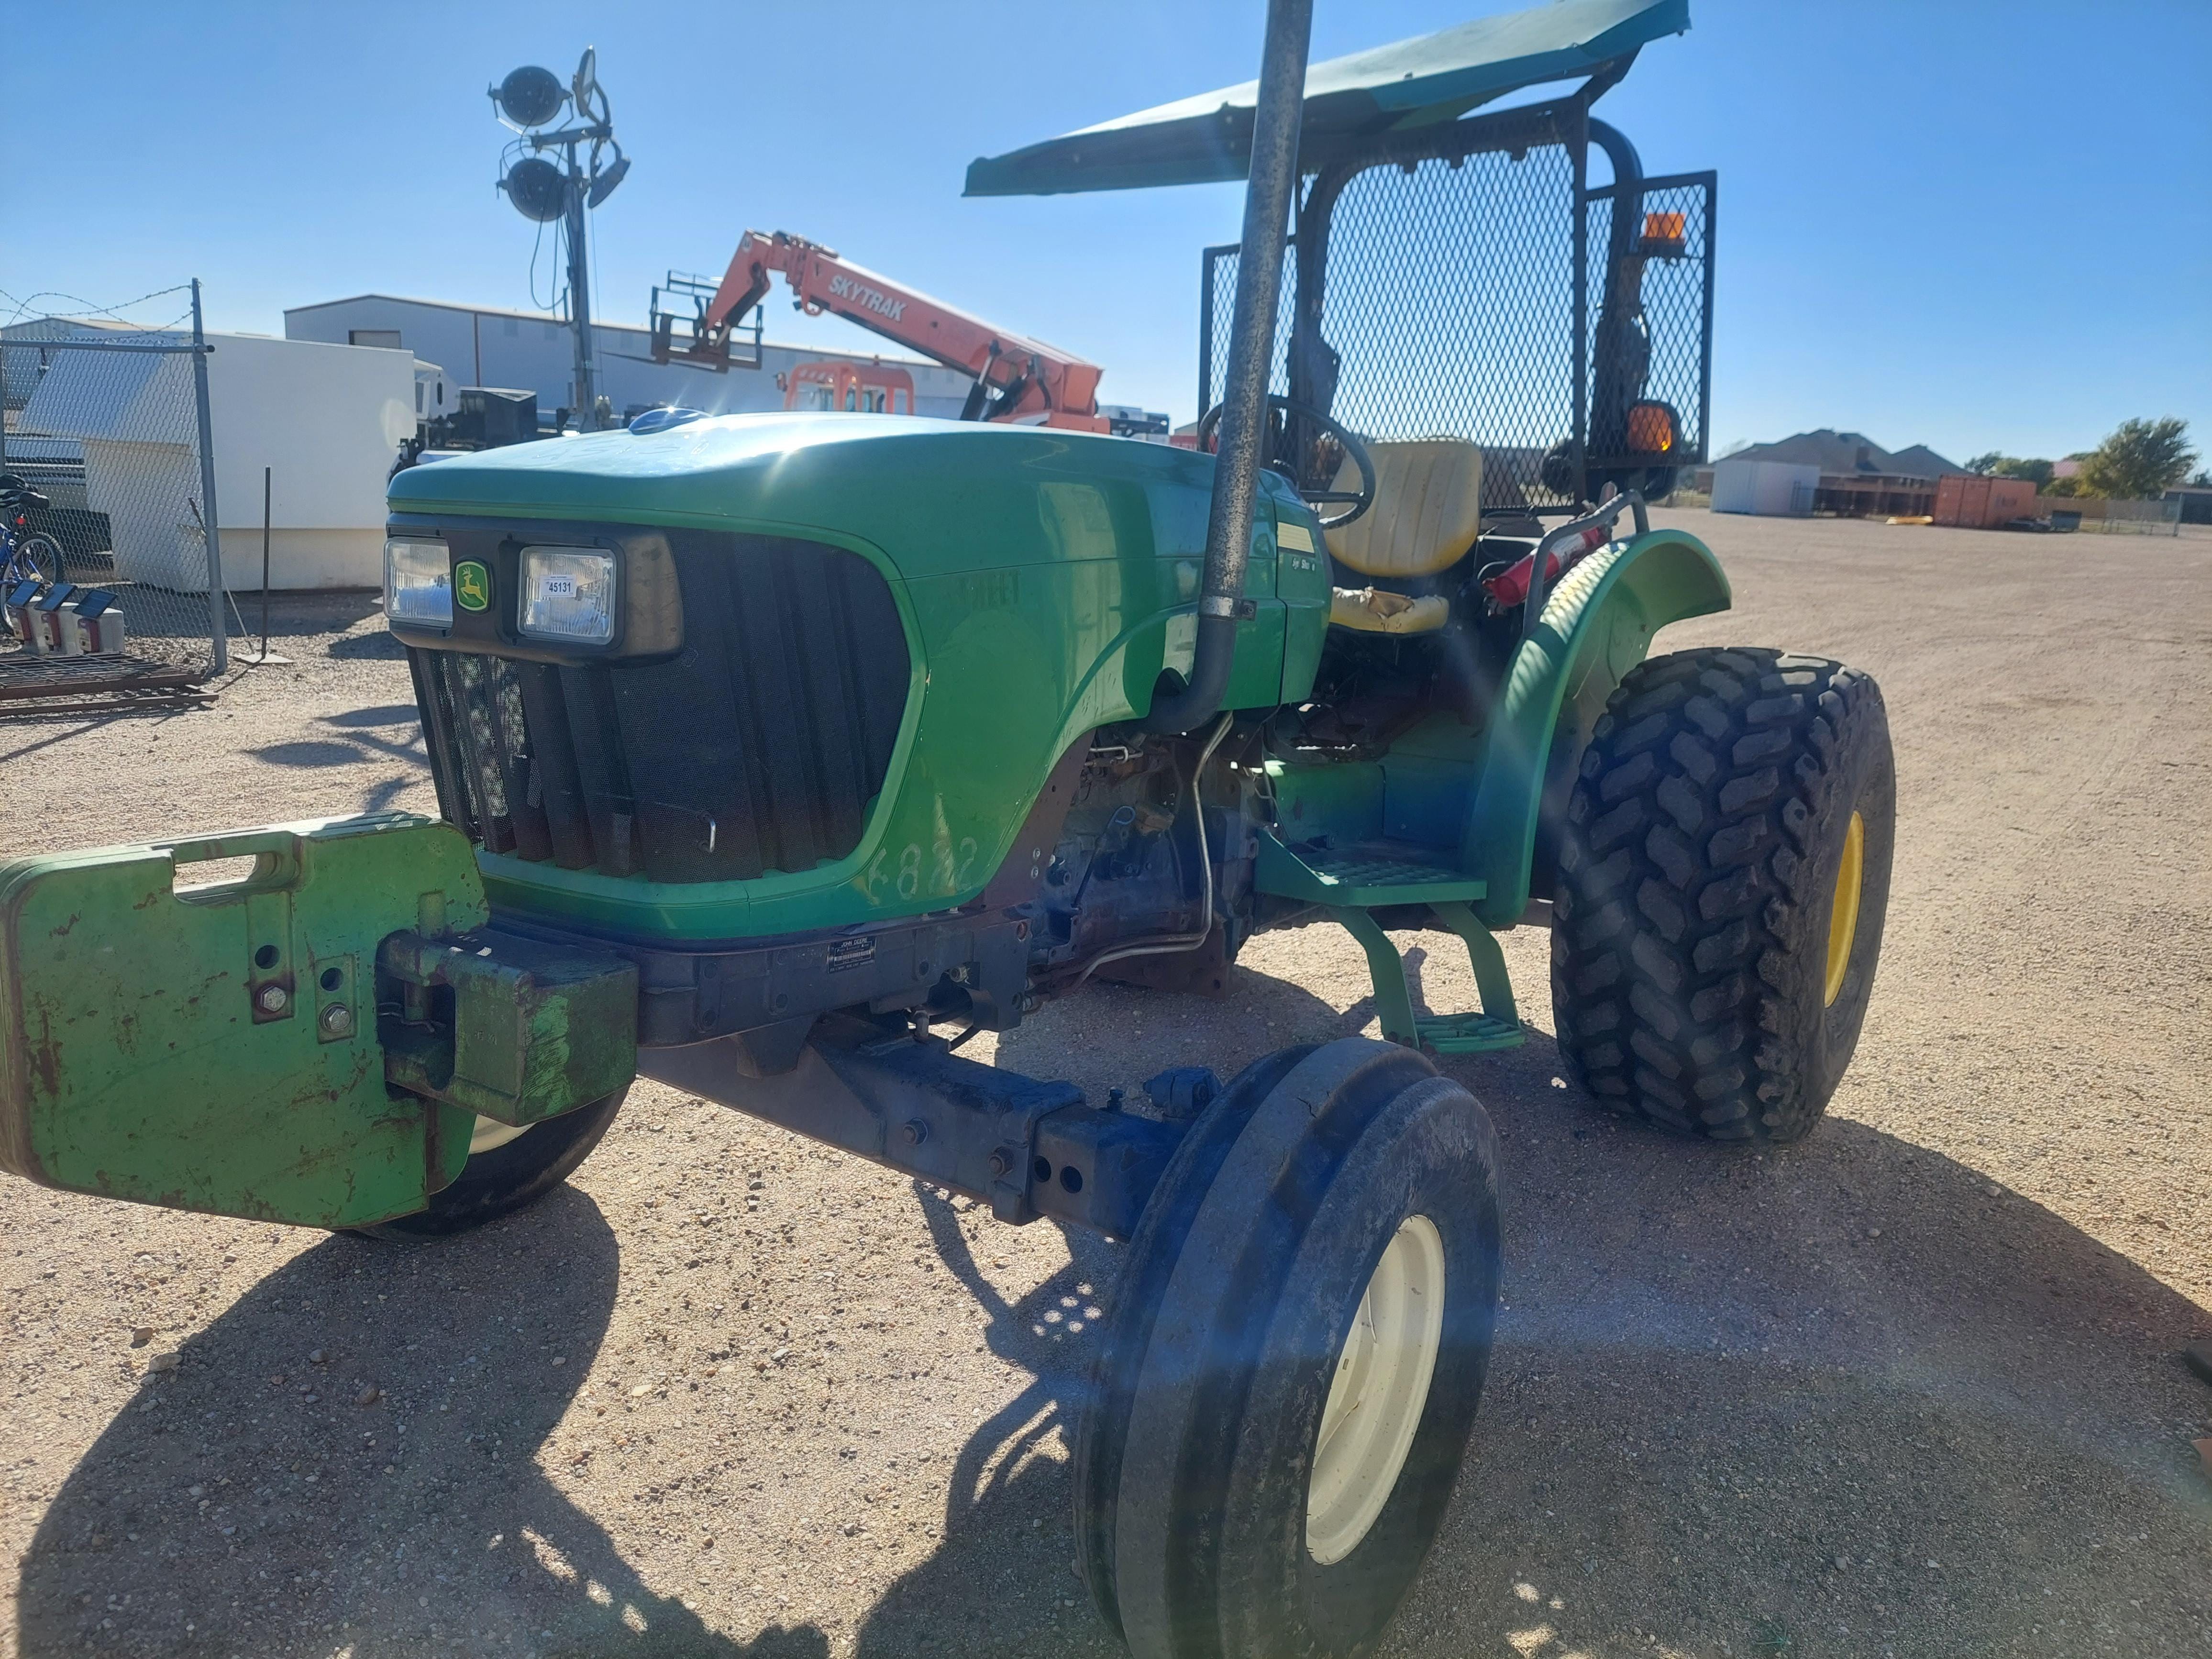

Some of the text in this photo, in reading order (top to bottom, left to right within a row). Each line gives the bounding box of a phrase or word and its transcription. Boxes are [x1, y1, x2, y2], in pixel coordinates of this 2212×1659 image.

[829, 275, 907, 322] SKYTRAK
[549, 582, 571, 592] 45131
[854, 937, 868, 945] DEERE
